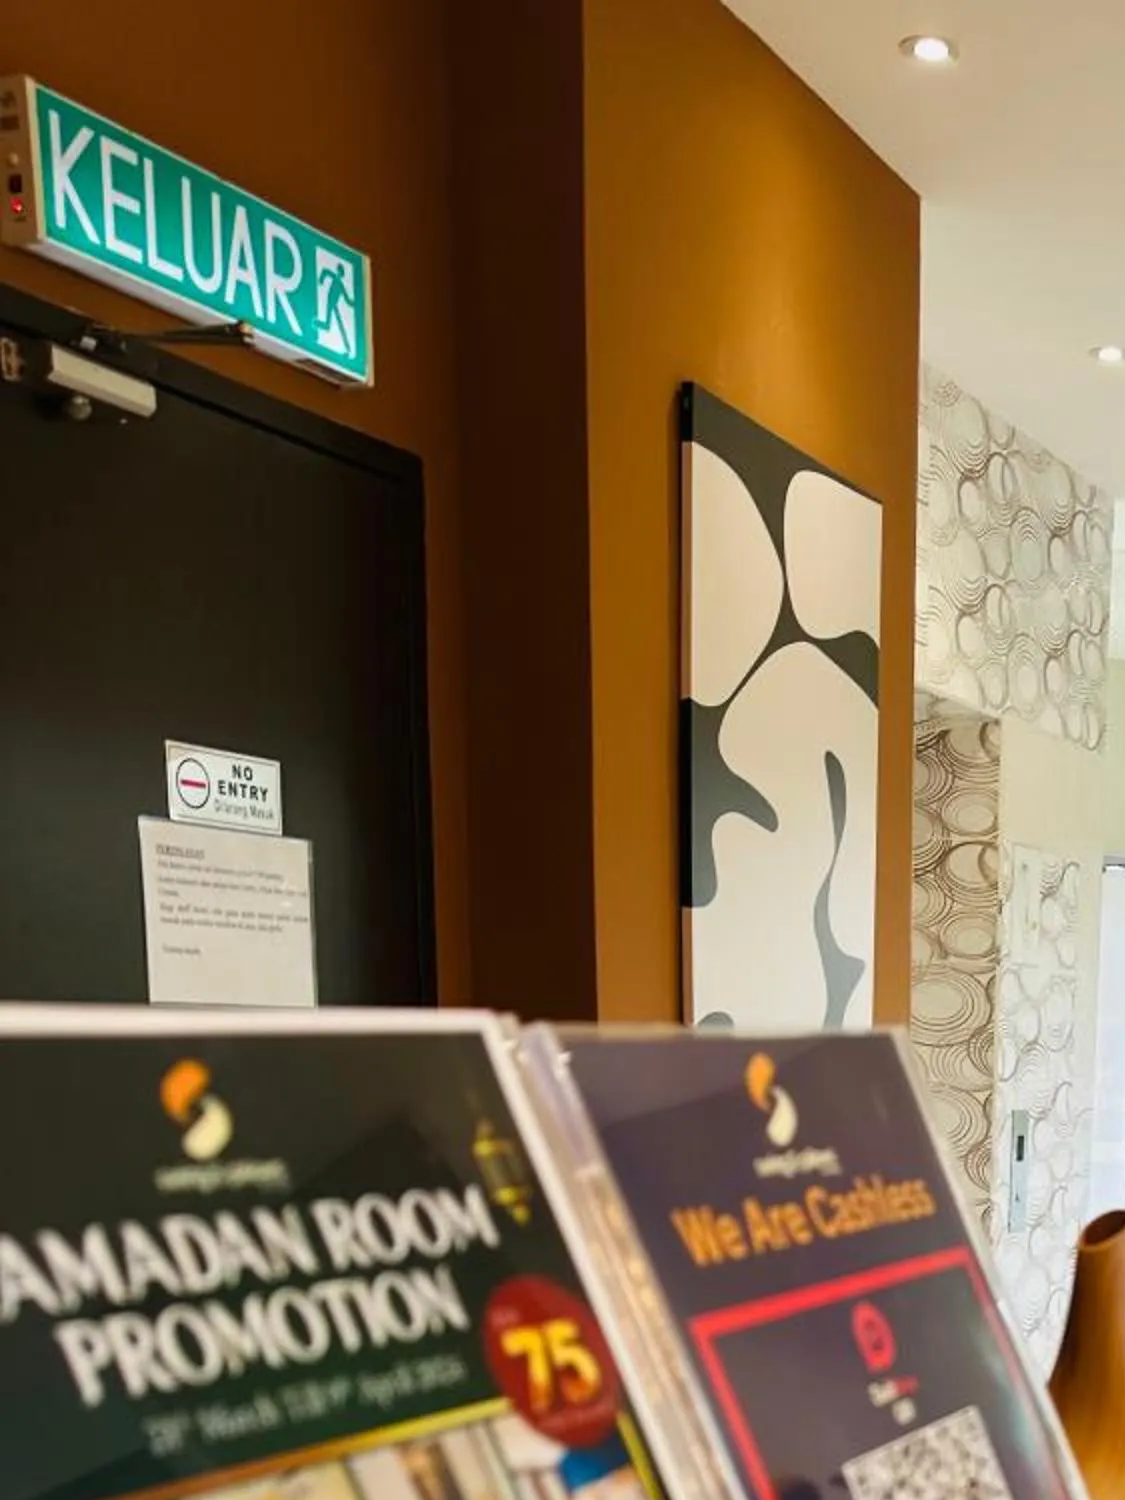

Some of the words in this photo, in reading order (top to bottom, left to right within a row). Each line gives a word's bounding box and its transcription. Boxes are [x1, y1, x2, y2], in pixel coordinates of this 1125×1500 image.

[47, 108, 304, 337] KELUAR
[217, 780, 268, 803] ENTRY
[231, 764, 253, 781] NO
[310, 1183, 501, 1272] ROOM
[669, 1203, 748, 1269] We
[742, 1195, 814, 1255] Are
[803, 1172, 937, 1239] Cashless
[53, 1262, 471, 1409] PROMOTION
[501, 1318, 601, 1416] 75
